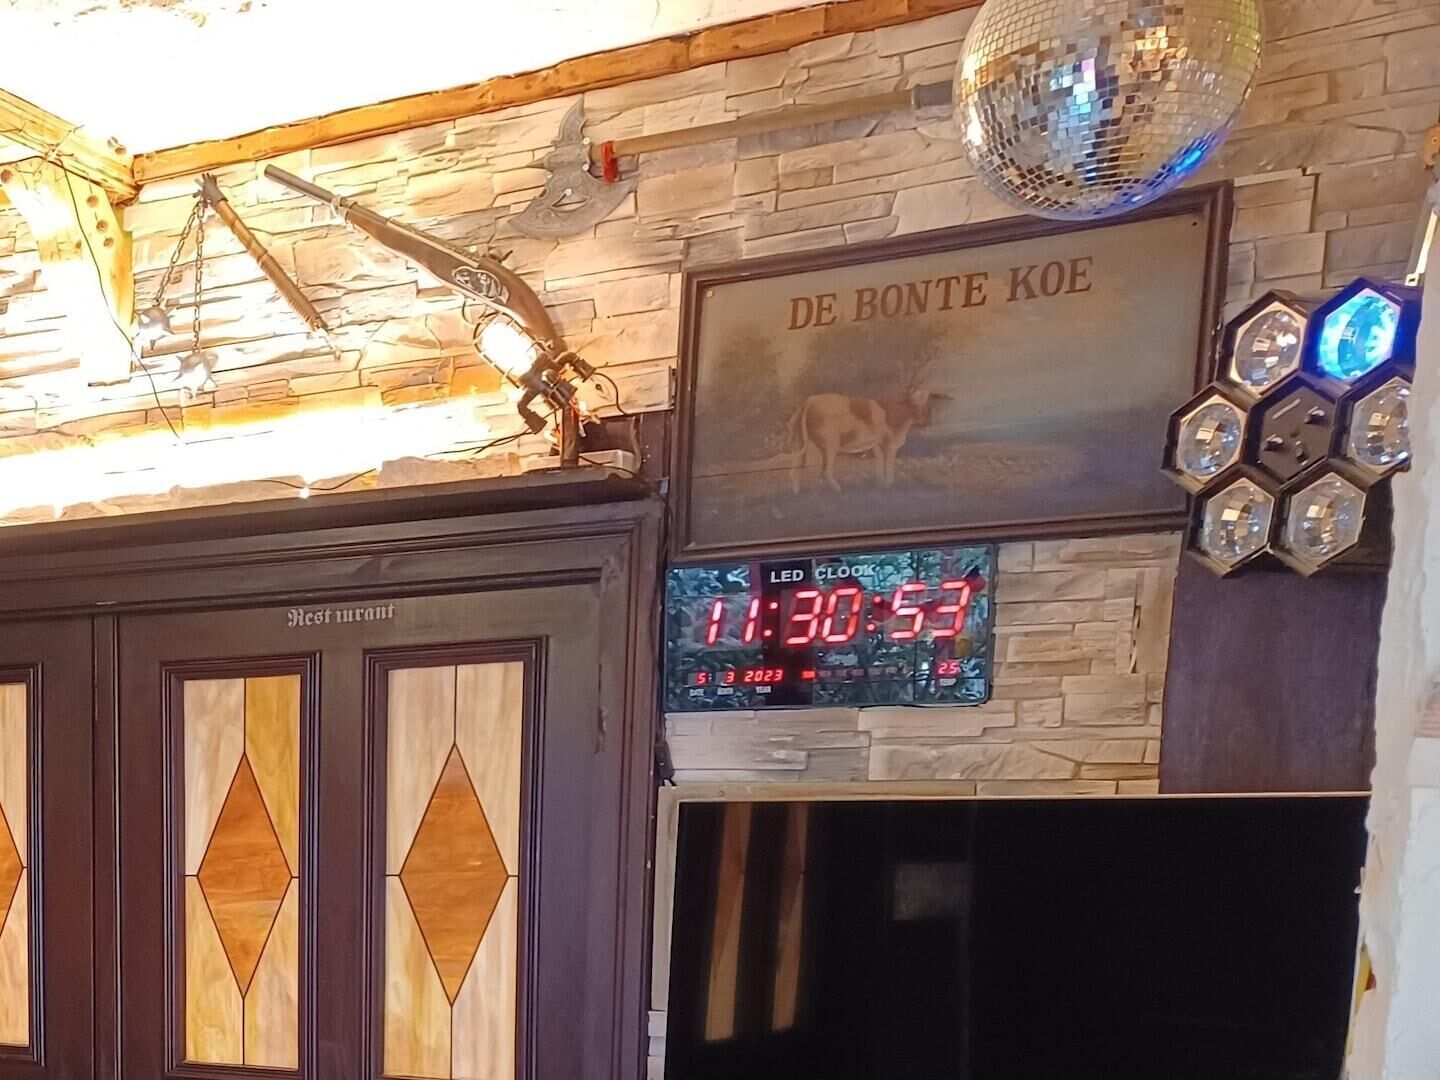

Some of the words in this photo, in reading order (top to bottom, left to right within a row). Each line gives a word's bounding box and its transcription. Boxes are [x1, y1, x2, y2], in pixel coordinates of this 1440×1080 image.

[788, 293, 837, 330] DE
[853, 272, 989, 322] BONTE
[1006, 256, 1094, 302] KOE
[770, 569, 805, 584] LED
[744, 669, 784, 683] 2023
